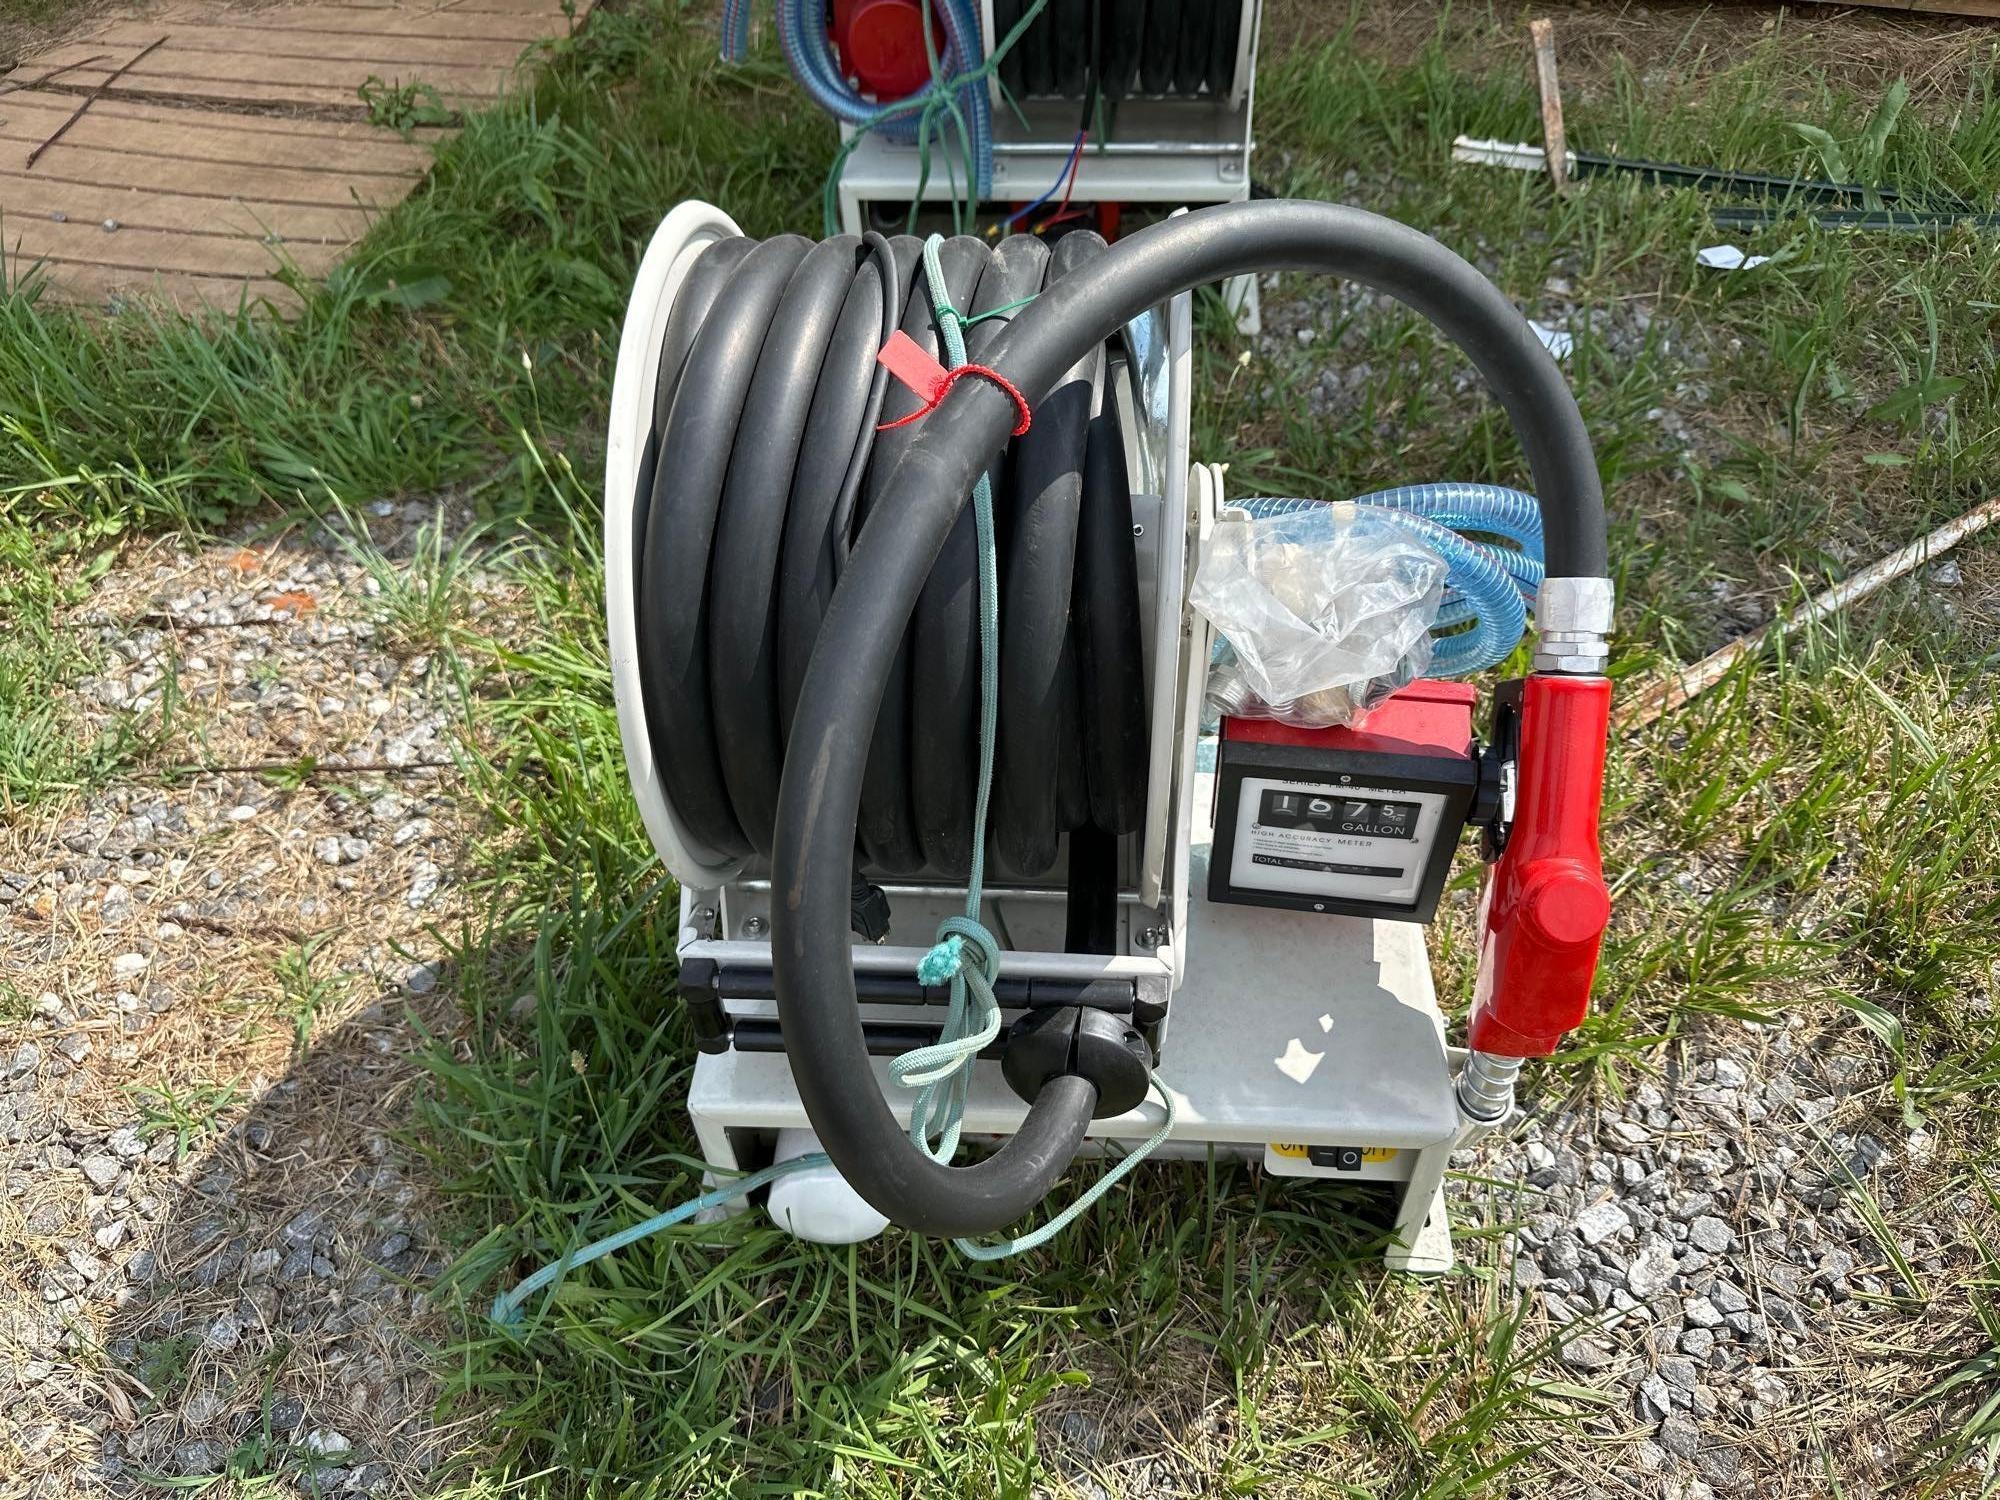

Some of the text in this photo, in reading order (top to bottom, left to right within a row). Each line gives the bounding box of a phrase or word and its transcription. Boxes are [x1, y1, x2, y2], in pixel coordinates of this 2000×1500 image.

[1341, 822, 1405, 835] GALLON
[1251, 829, 1373, 848] HIGH ACCURACY METER
[1253, 855, 1283, 866] TOTAL
